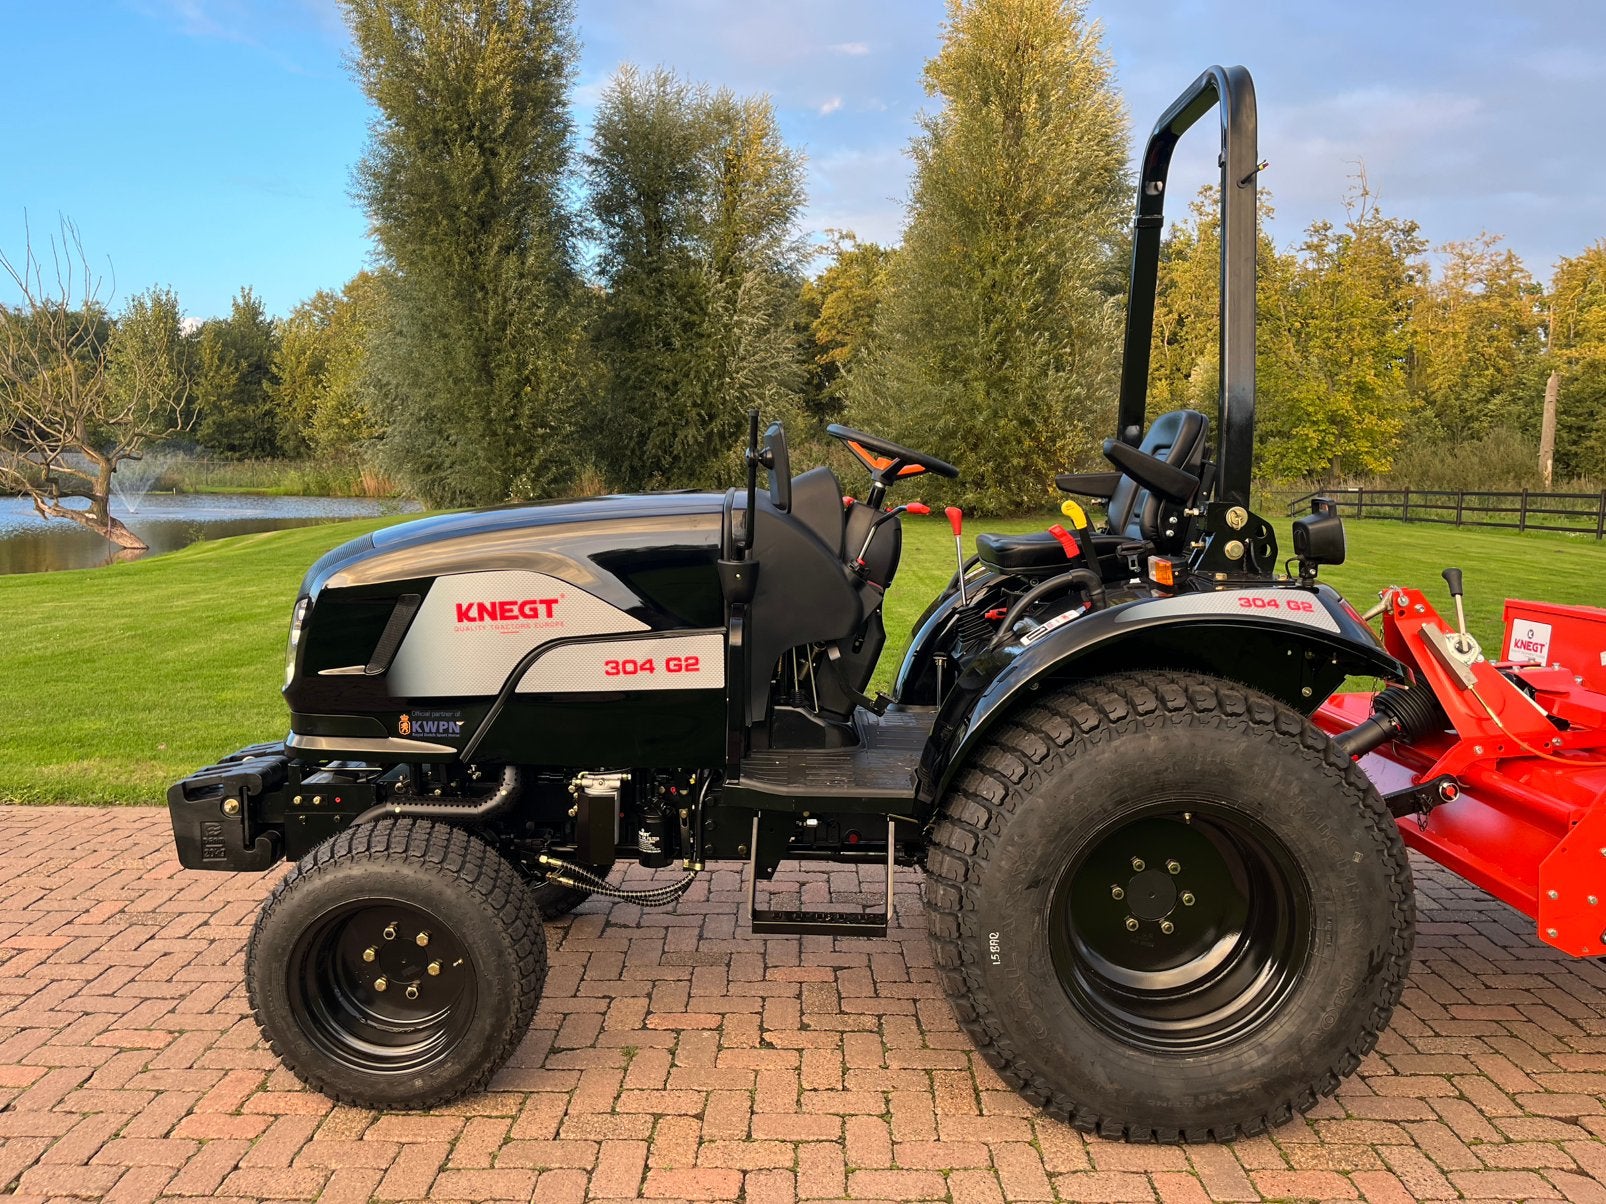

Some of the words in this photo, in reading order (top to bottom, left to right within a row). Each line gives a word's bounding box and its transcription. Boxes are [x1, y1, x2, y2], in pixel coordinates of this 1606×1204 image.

[456, 598, 559, 623] KNEGT
[1238, 597, 1280, 609] 304
[1286, 600, 1314, 612] G2
[491, 623, 531, 631] TRACTORS
[535, 621, 565, 629] EUROPE
[1514, 638, 1545, 654] KNEGT
[604, 658, 656, 676] 304
[665, 655, 700, 673] G2
[411, 721, 460, 733] KWPN
